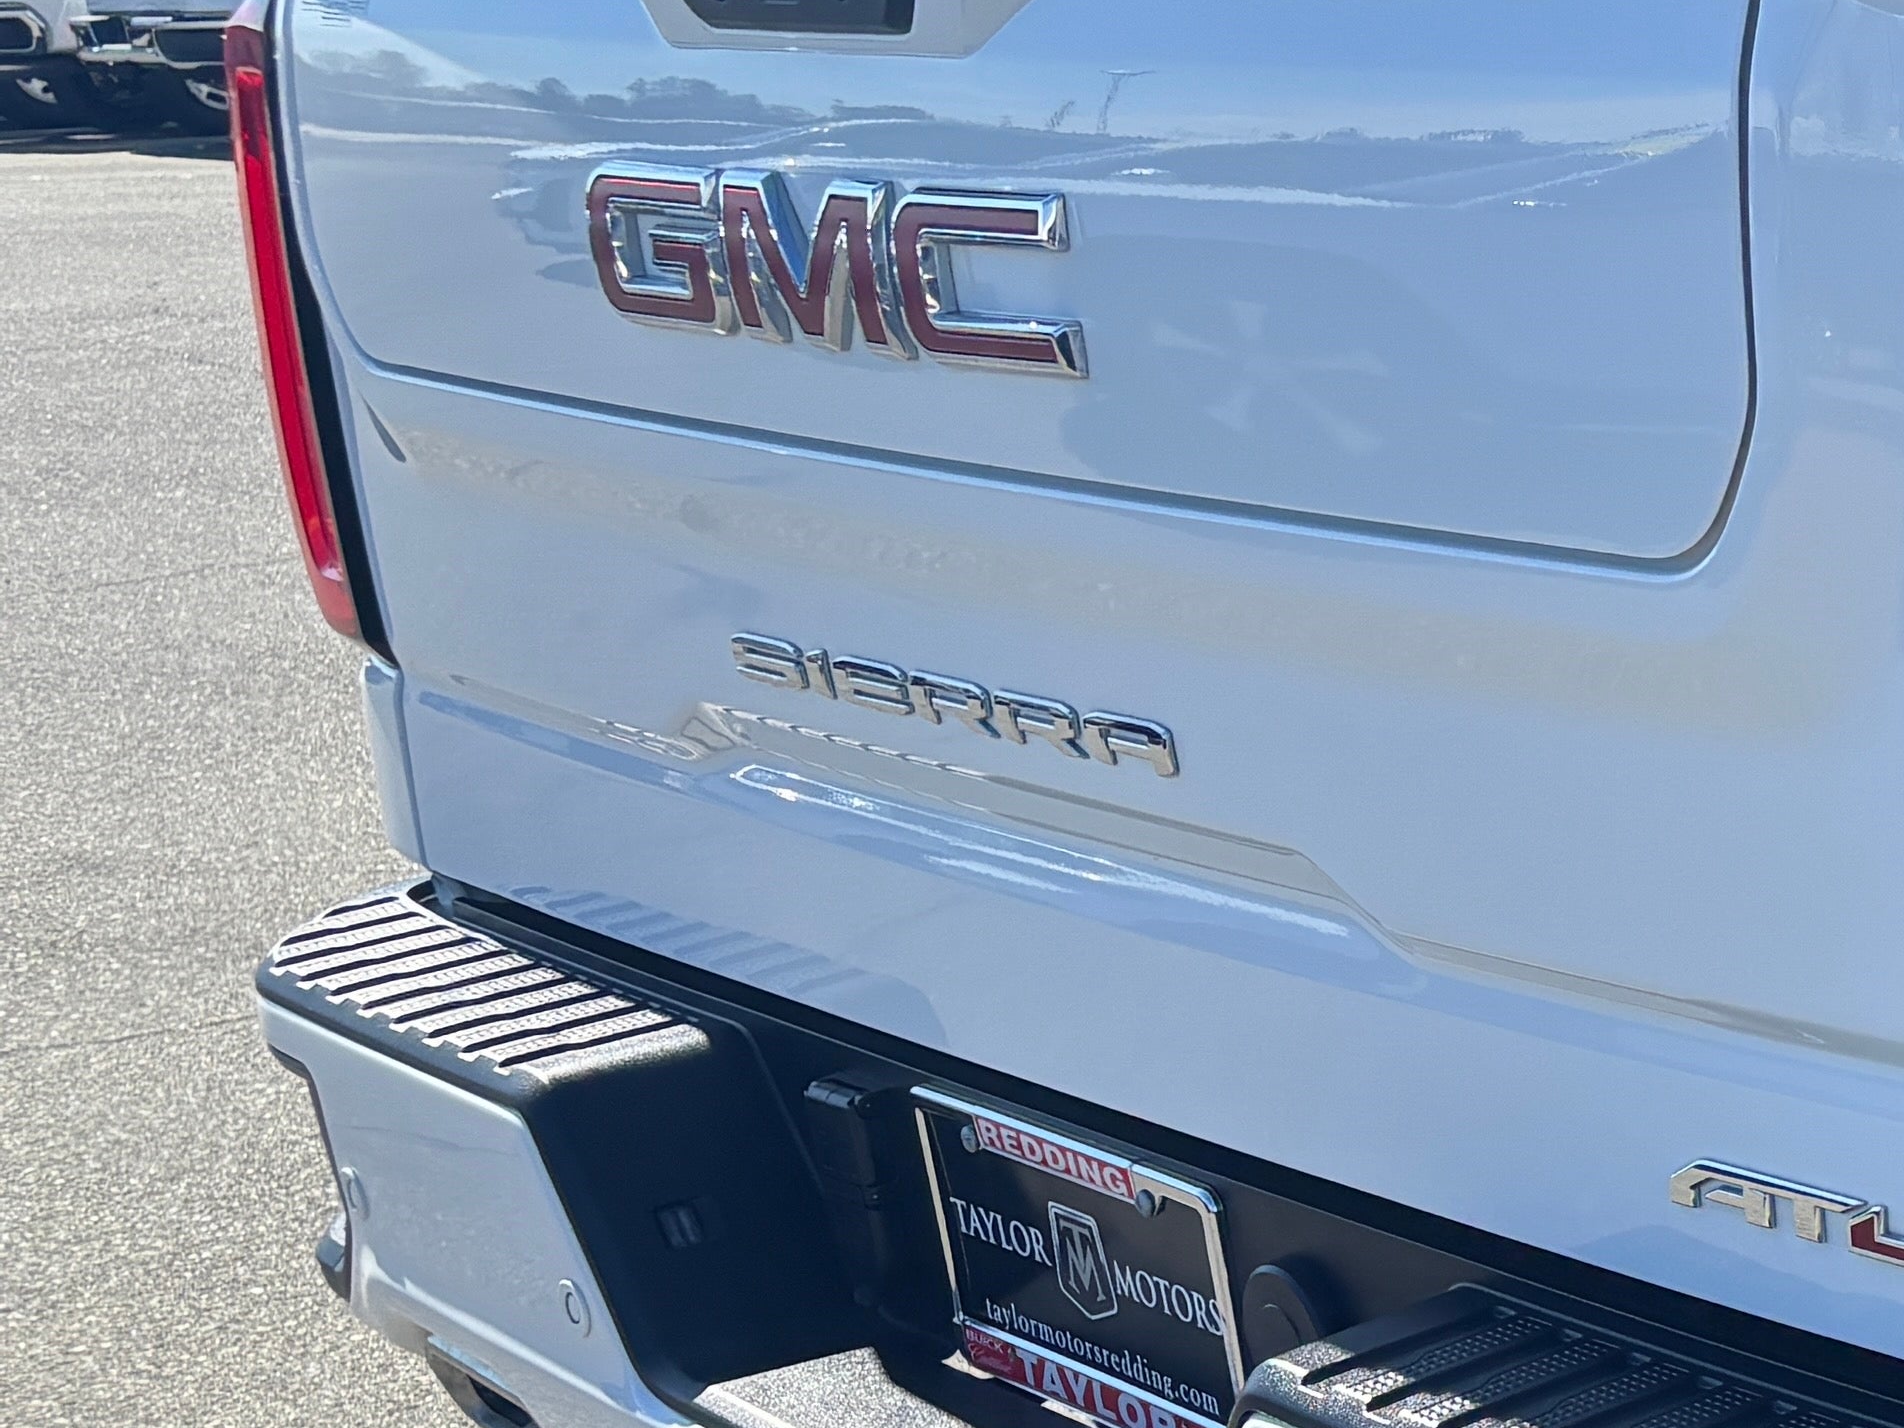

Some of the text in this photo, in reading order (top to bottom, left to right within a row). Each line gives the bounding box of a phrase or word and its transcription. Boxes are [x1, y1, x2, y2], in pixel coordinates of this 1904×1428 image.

[585, 159, 1090, 380] GMC
[731, 631, 1180, 778] SIERRA
[977, 1118, 1133, 1197] REDDING
[950, 1196, 1053, 1267] TAYLOR
[1113, 1260, 1224, 1337] MOTORS
[986, 1298, 1221, 1417] taylormotorsredding.com
